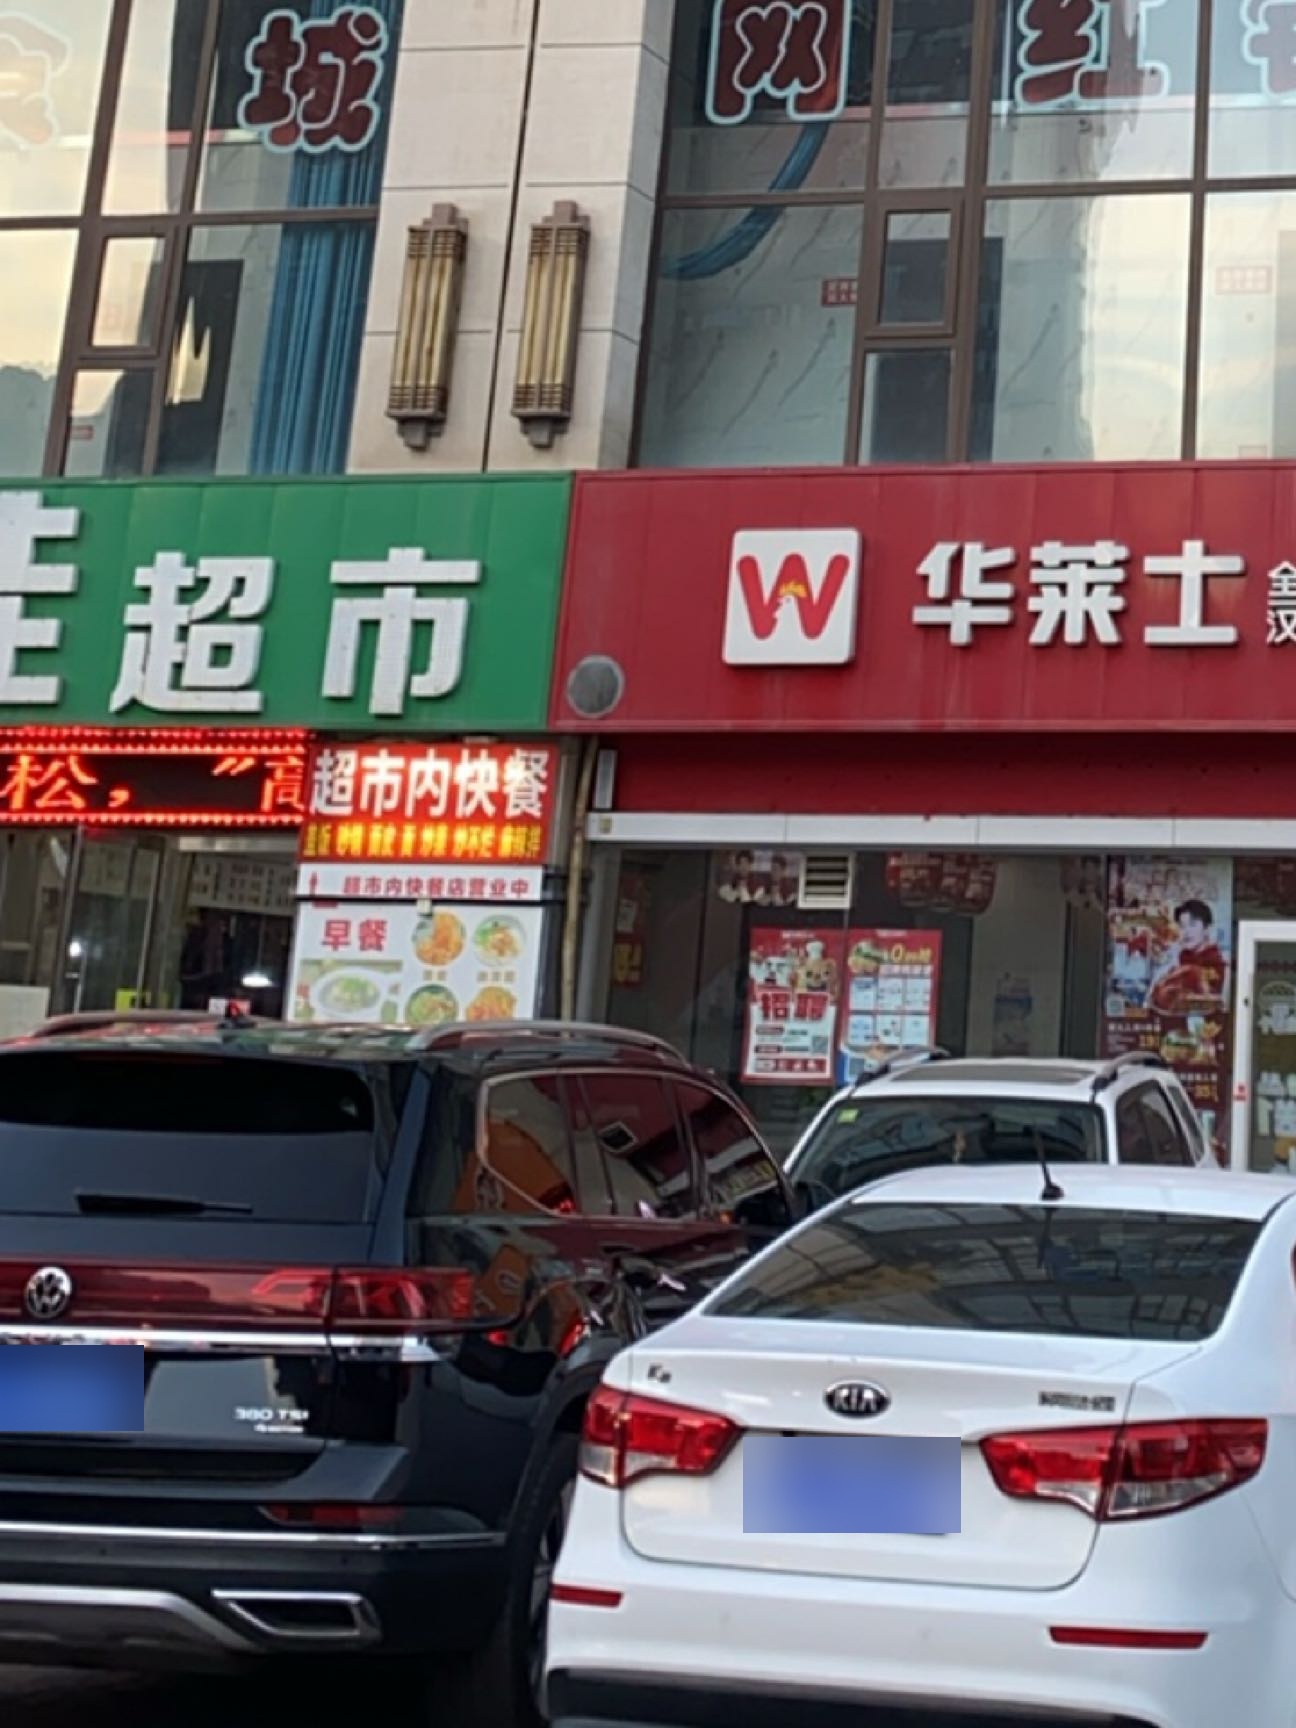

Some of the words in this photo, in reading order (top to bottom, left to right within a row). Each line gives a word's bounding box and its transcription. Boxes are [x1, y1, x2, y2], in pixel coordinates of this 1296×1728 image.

[911, 539, 1246, 647] 华莱士
[308, 747, 549, 819] 超市内快餐
[321, 918, 388, 952] 早餐
